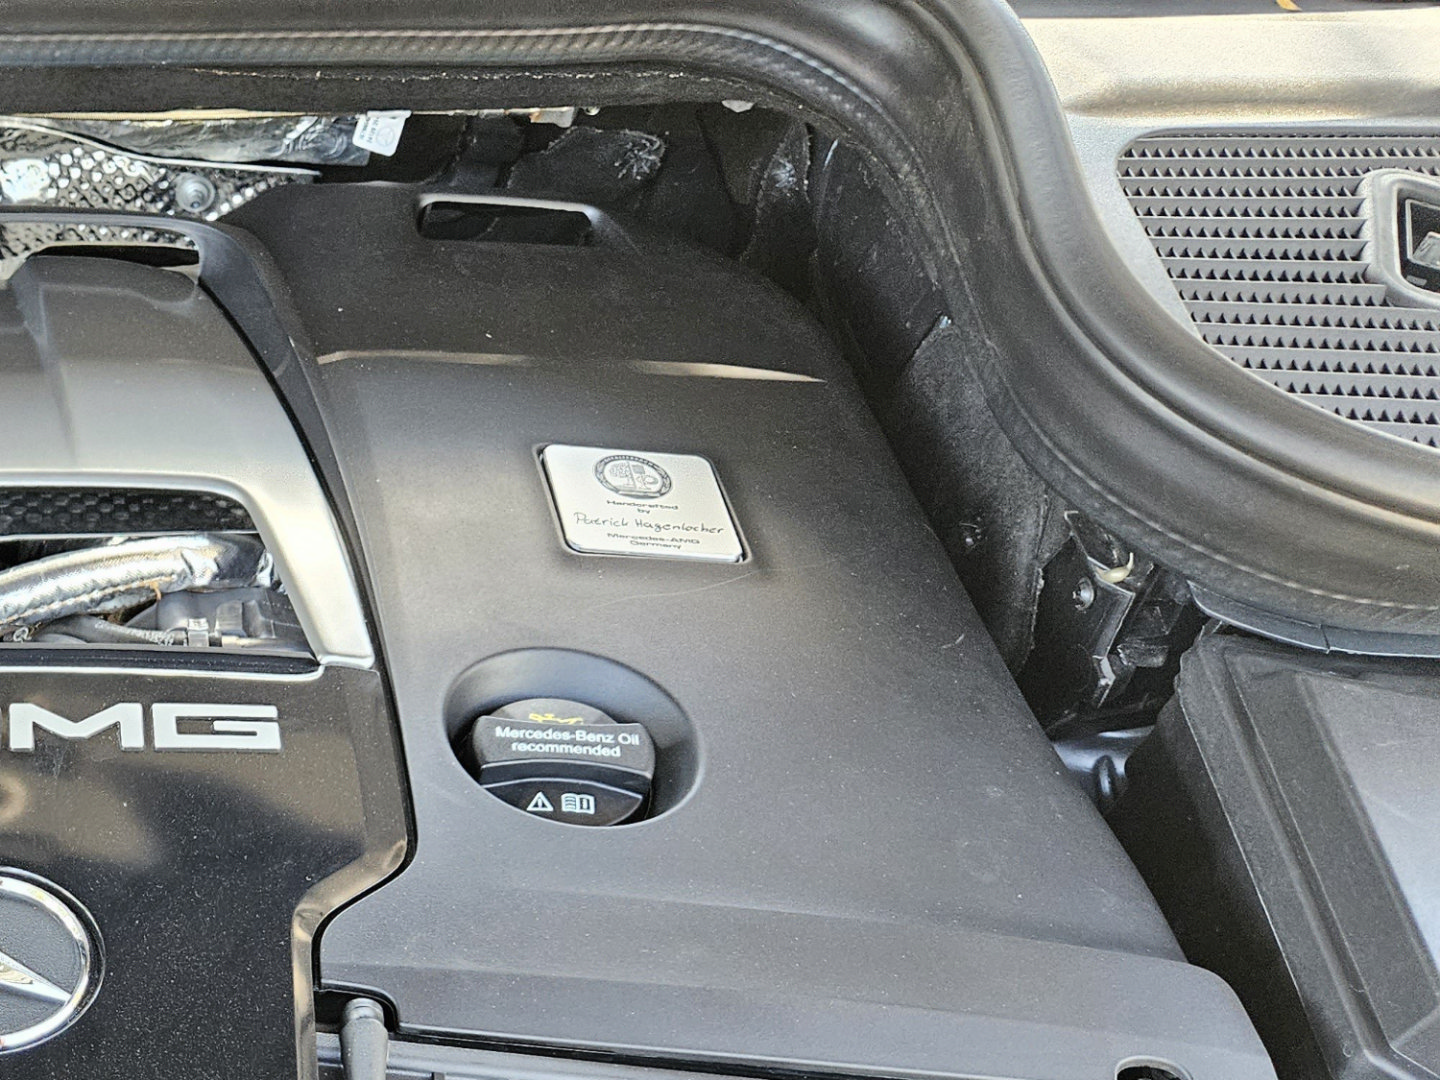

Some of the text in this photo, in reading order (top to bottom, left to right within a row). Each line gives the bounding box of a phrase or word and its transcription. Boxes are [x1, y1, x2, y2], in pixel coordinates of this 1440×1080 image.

[637, 507, 651, 515] by
[573, 511, 629, 527] Patrick
[606, 532, 701, 545] Mercedes-AMG
[629, 540, 683, 550] Germany
[494, 725, 641, 746] Mercedes-Benz Oil
[511, 740, 622, 758] recommended
